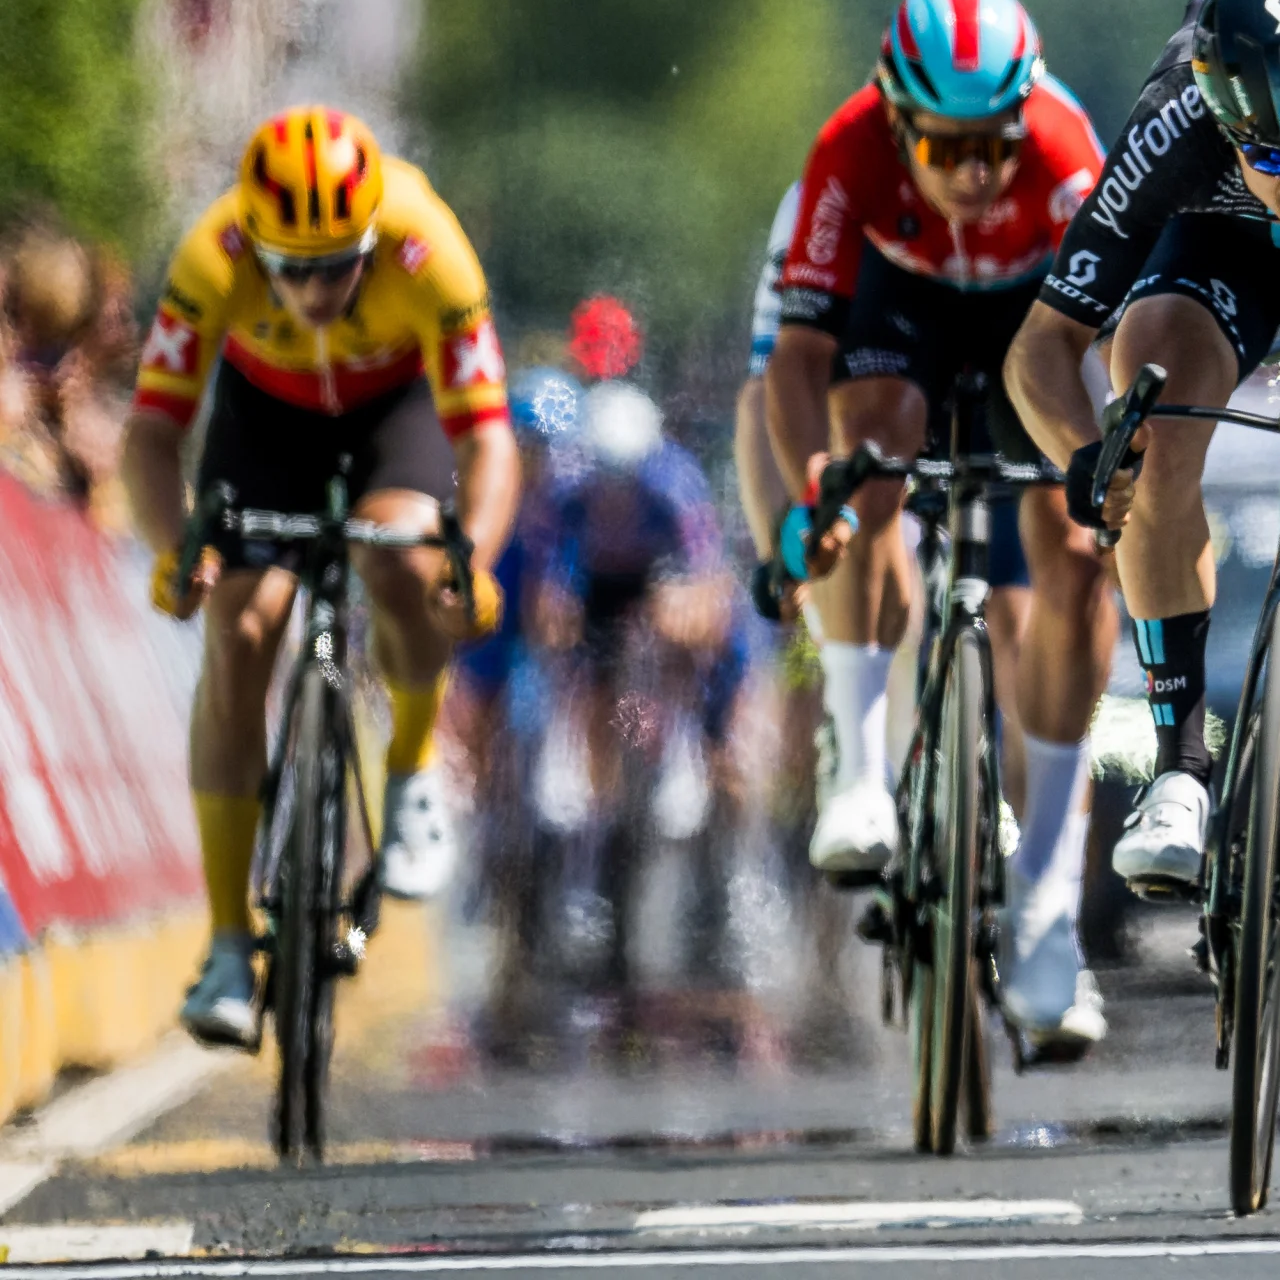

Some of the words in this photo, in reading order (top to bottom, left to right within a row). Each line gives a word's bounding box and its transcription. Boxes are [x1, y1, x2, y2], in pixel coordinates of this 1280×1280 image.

[1090, 84, 1206, 240] youfone
[1044, 273, 1109, 312] SCOTT
[1154, 675, 1187, 693] DSM
